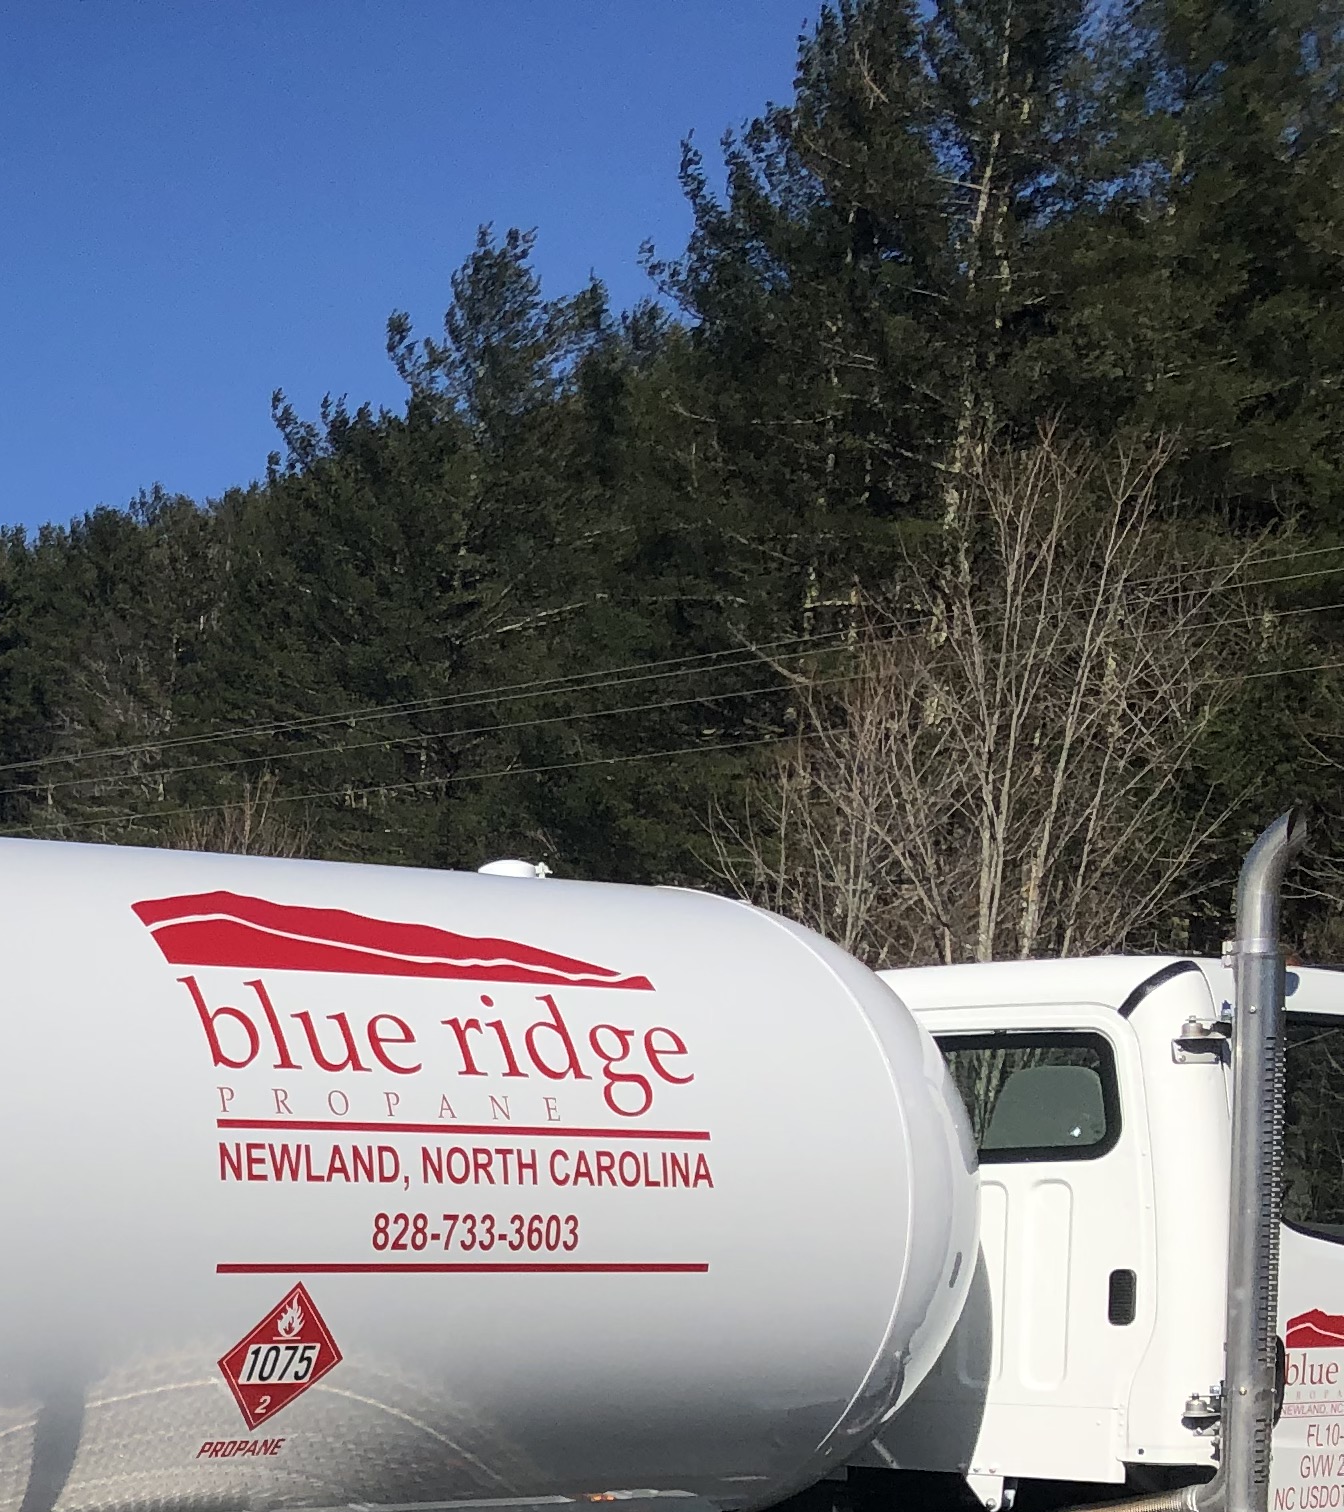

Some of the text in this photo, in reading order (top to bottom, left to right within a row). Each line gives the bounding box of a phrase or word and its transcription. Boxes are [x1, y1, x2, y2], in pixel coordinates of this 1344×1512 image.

[176, 975, 694, 1117] blue ridge
[217, 1086, 561, 1122] PROPANE
[219, 1142, 714, 1191] NEWLAND, NORTH CAROLINA
[372, 1212, 580, 1252] 828-733-3603
[246, 1345, 316, 1382] 1075
[1284, 1353, 1339, 1386] blue
[254, 1395, 272, 1414] 2
[196, 1438, 286, 1459] PROPANE
[1300, 1453, 1335, 1479] GVW
[1274, 1486, 1296, 1511] NC
